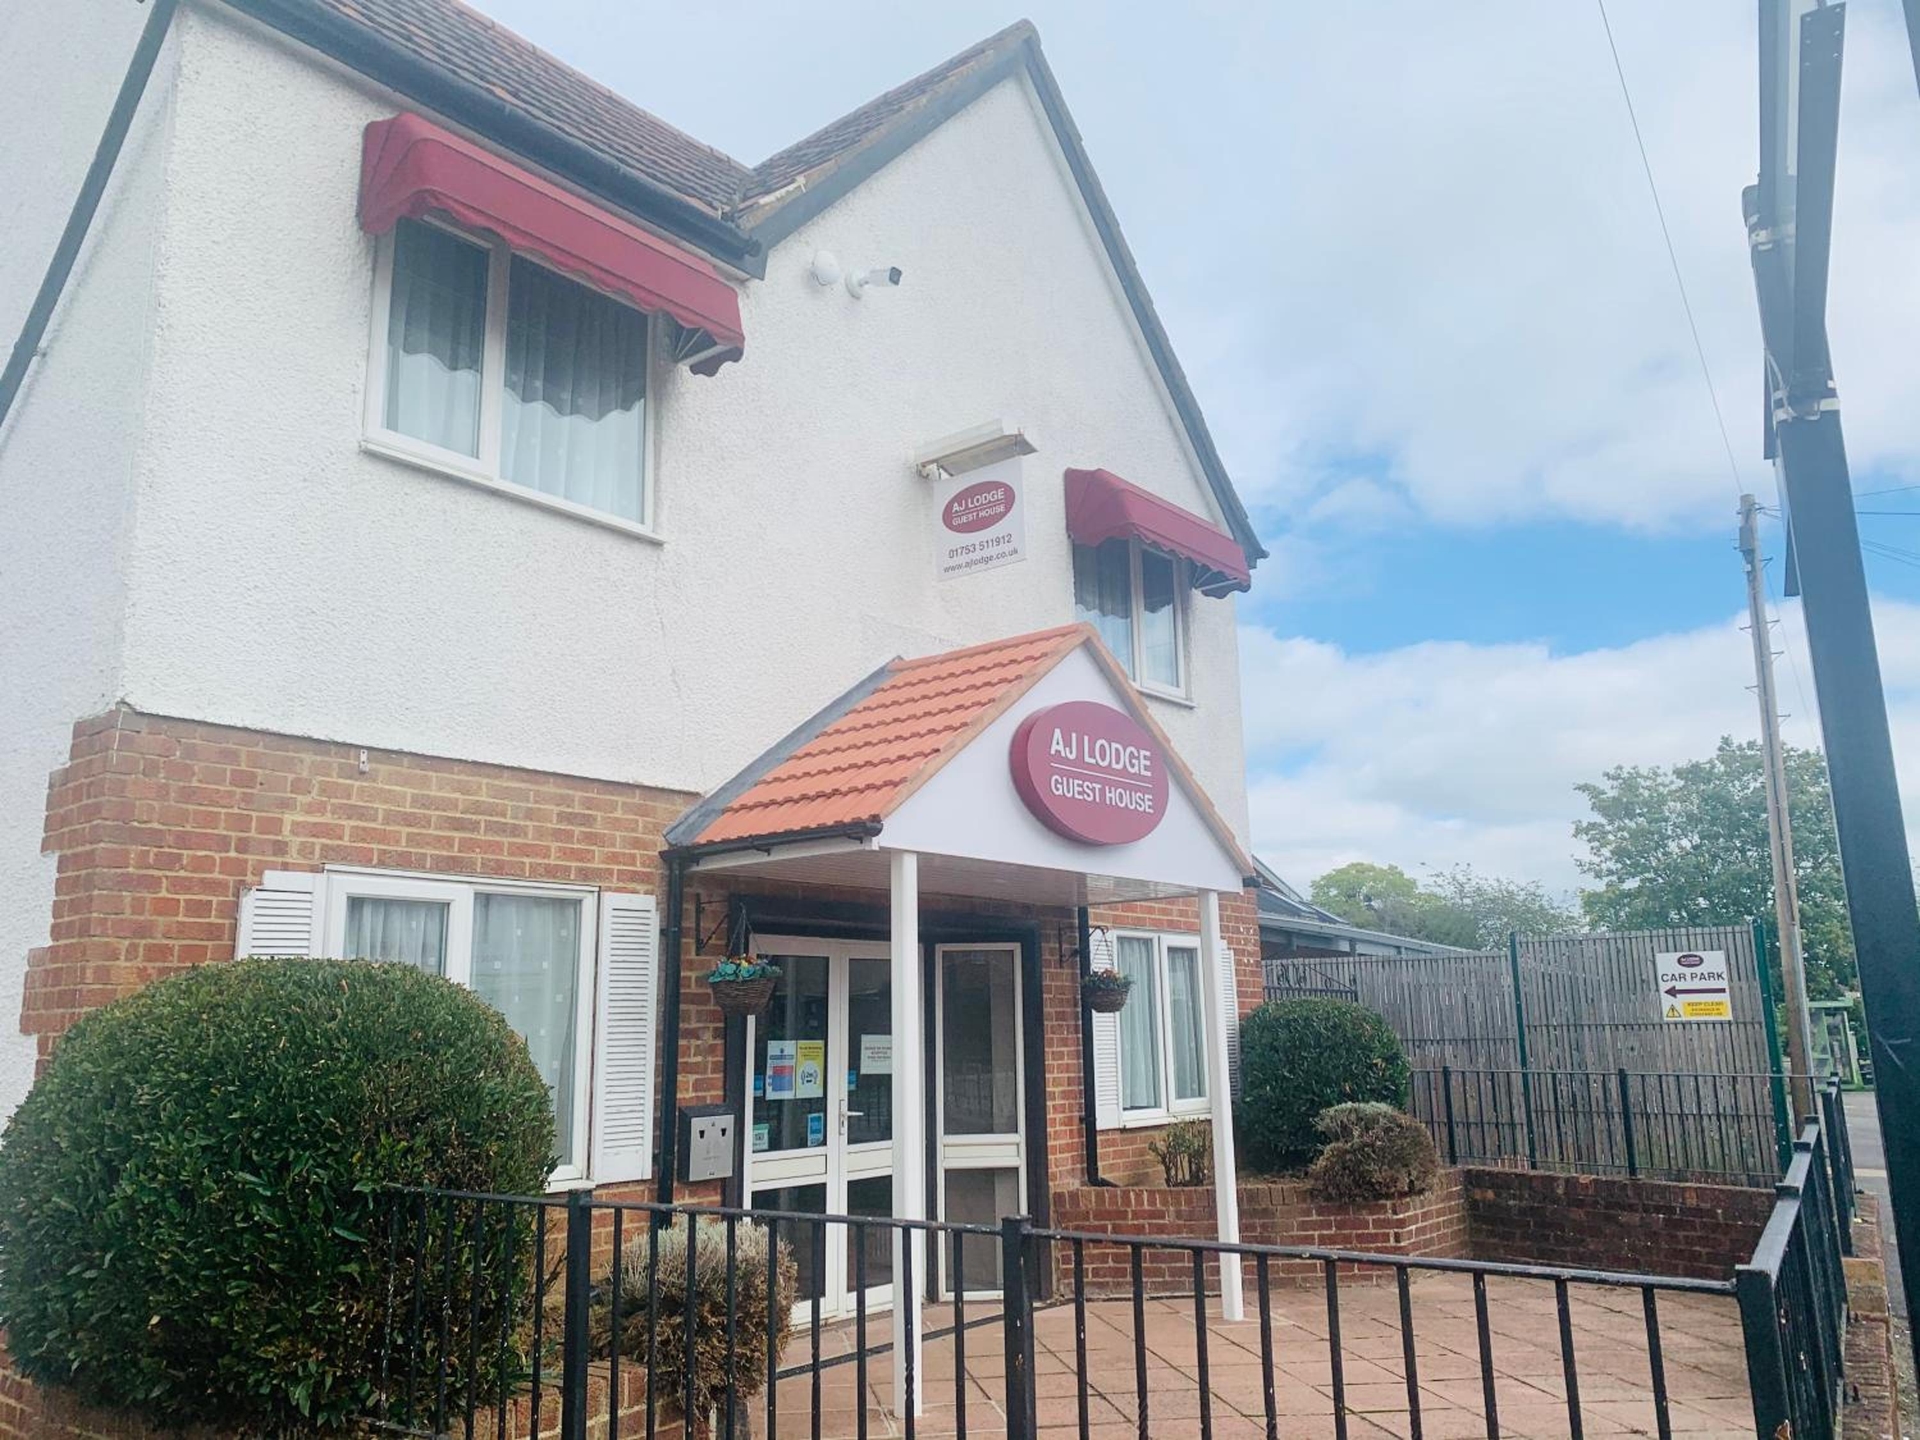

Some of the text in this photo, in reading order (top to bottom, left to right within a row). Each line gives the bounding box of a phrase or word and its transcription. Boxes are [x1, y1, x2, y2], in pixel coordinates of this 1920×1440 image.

[951, 488, 1005, 513] AJ LODGE
[951, 503, 1006, 526] GUEST HOUSE
[948, 533, 1013, 559] 01753 511912
[943, 547, 1019, 573] www.ajlodge.co.uk
[1050, 728, 1153, 777] AJ LODGE
[1050, 775, 1154, 813] GUEST HOUSE
[1660, 971, 1726, 983] CAR PARK
